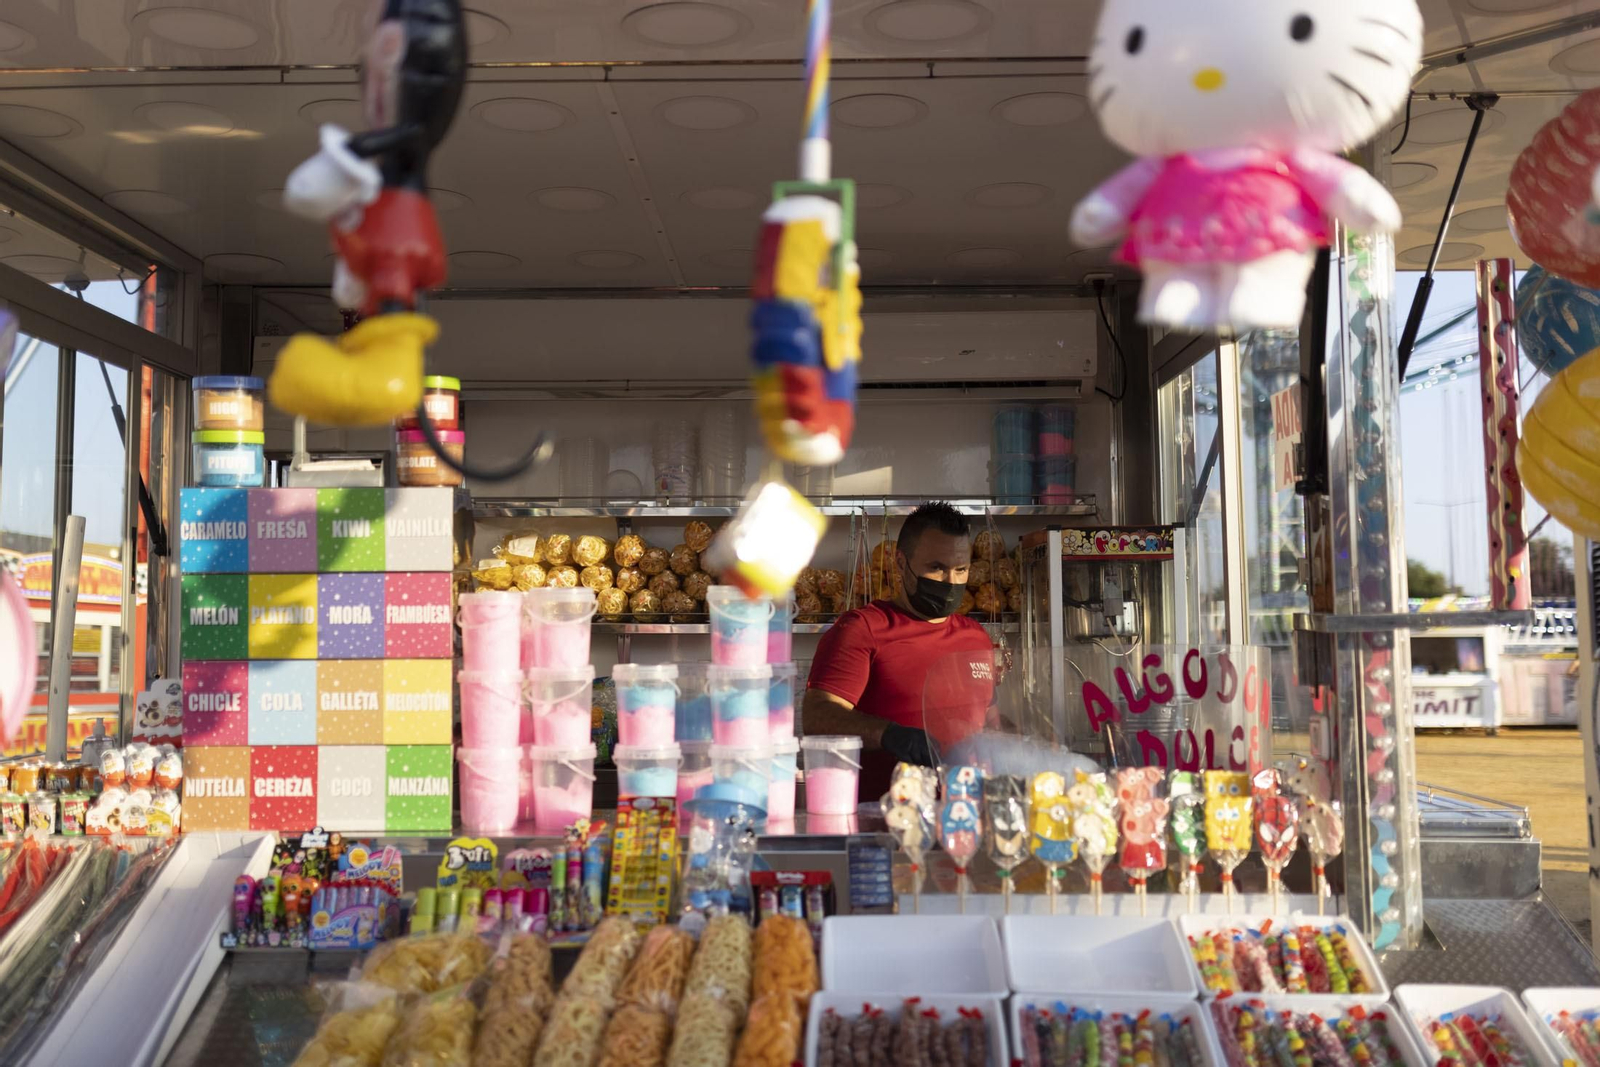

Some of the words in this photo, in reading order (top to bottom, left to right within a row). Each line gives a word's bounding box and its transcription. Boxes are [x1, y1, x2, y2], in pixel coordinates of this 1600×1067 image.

[180, 520, 247, 540] CARAMELO
[256, 520, 307, 539] FRESA
[331, 520, 371, 538] KIWI
[388, 519, 452, 538] VAINILLA
[189, 604, 239, 626] MELÓN
[329, 606, 372, 625] MORA
[386, 605, 450, 625] FRAMBUESA
[187, 691, 242, 712] CHICLE
[260, 692, 303, 712] COLA
[320, 691, 379, 711] GALLETA
[1414, 695, 1479, 715] IMIT
[185, 777, 246, 797] NUTELLA
[253, 776, 313, 797] CEREZA
[330, 777, 372, 797] COCO
[388, 777, 449, 797] MANZANA
